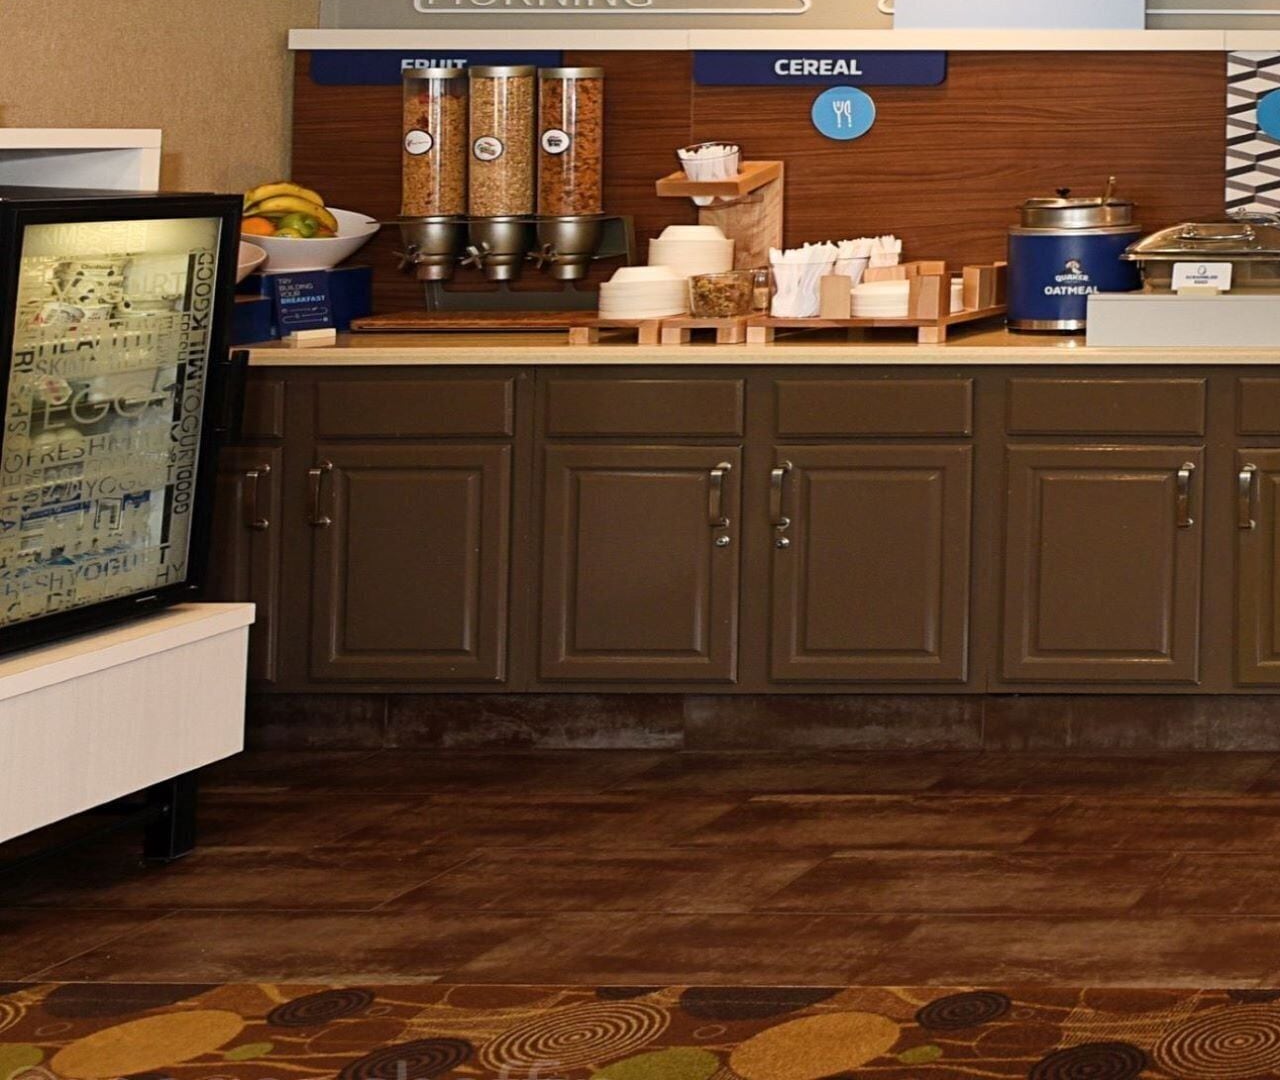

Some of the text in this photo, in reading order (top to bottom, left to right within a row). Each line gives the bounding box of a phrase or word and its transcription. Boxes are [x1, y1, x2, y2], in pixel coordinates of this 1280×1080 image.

[401, 58, 467, 73] FRUIT
[774, 59, 863, 76] CEREAL
[1044, 285, 1100, 296] OATMEAL
[281, 295, 326, 305] BREAKFAST
